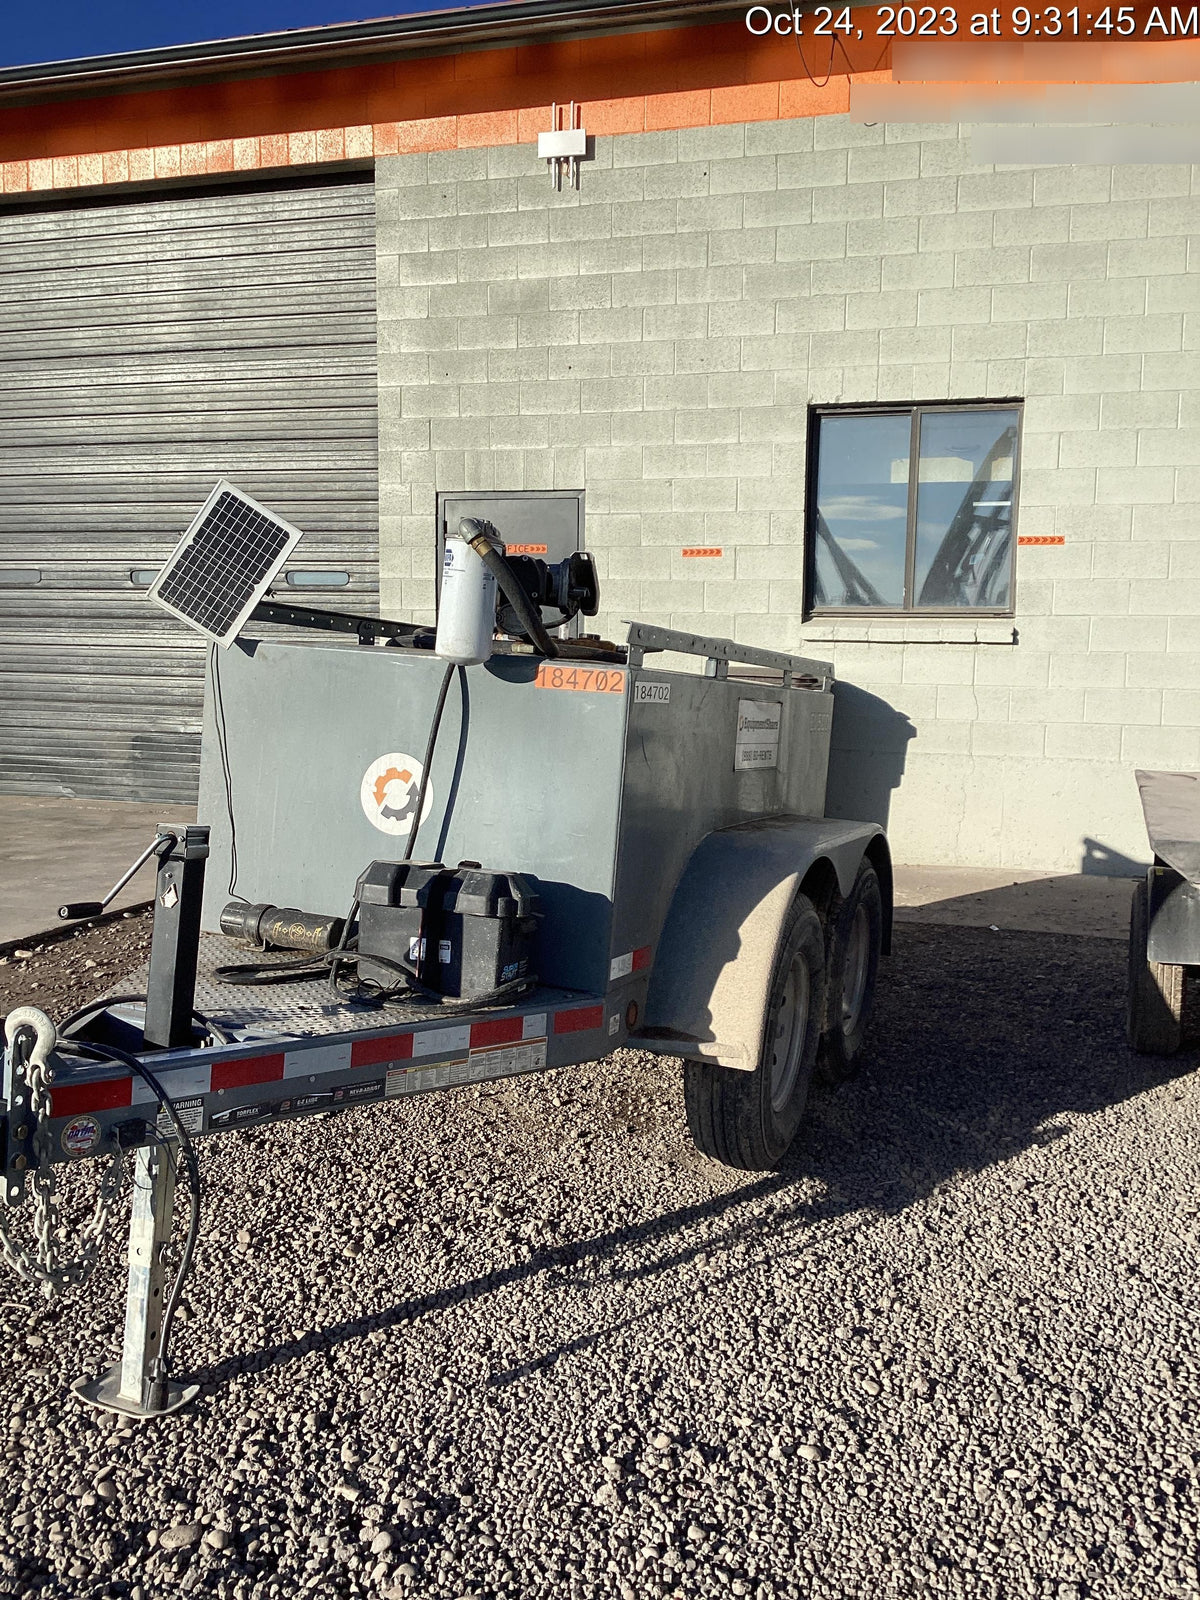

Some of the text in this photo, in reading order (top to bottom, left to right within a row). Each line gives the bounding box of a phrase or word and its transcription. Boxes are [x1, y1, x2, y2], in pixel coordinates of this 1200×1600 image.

[507, 543, 530, 553] FICE
[537, 666, 623, 693] 184702
[634, 685, 670, 701] 184702
[172, 1098, 202, 1110] ARNING
